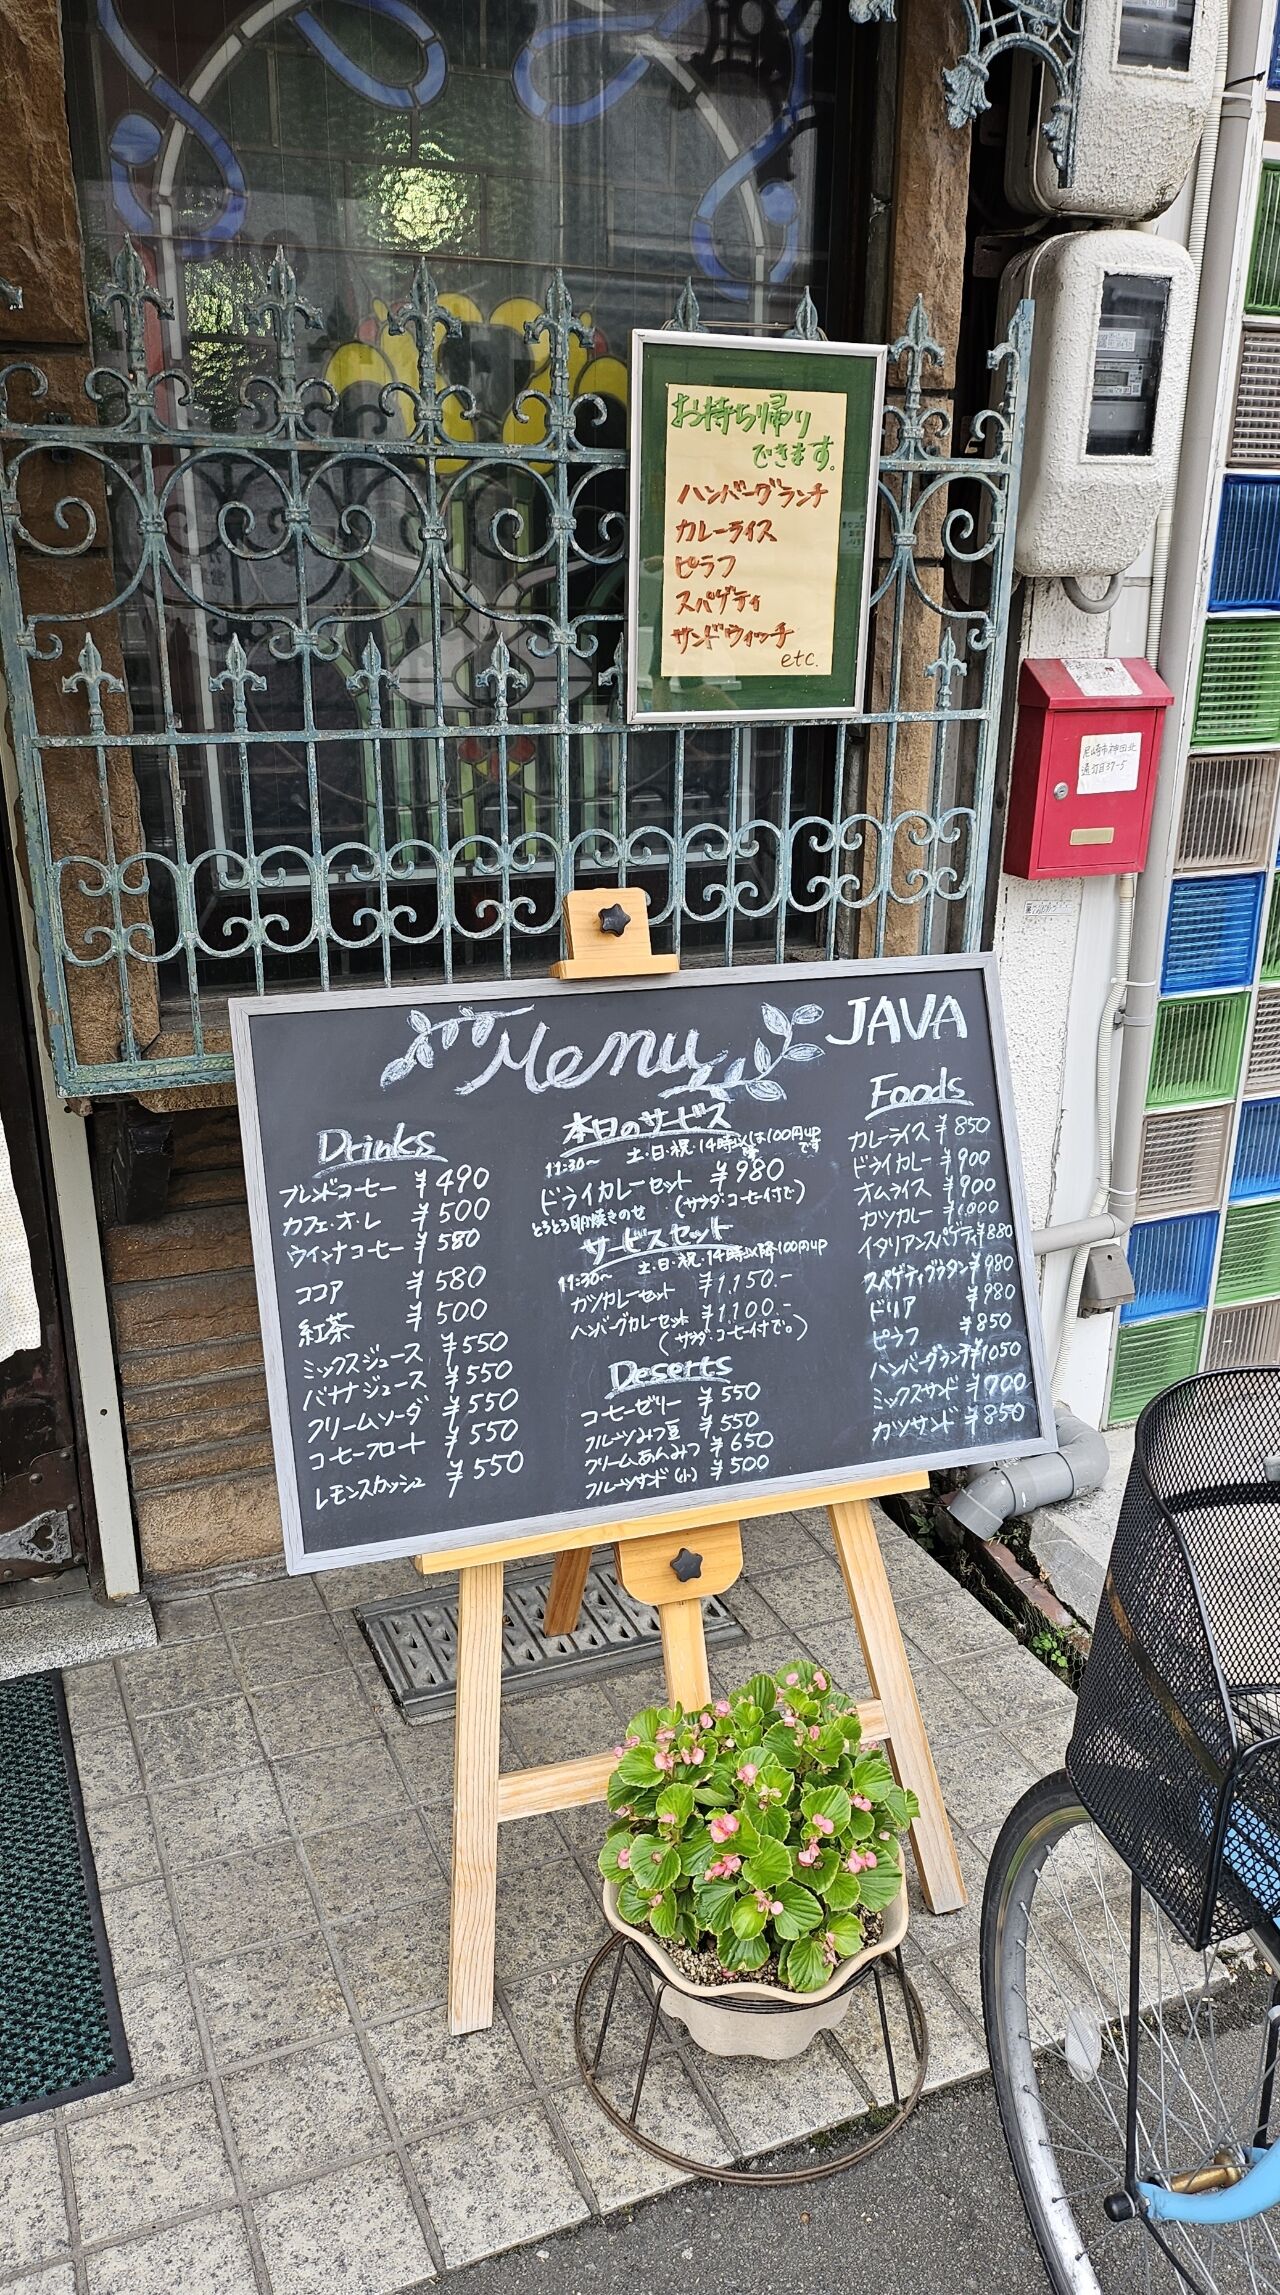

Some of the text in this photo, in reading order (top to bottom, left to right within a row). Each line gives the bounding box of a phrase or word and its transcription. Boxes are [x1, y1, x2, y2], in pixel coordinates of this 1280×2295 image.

[671, 393, 811, 438] お持ち帰り
[752, 435, 836, 471] できます。
[677, 479, 828, 508] ハンバーグランチ
[676, 519, 778, 544] カレーライス
[675, 555, 736, 579] ピラフ
[675, 586, 761, 615] スパゲティ
[671, 622, 794, 654] サンドウィッチ
[781, 650, 819, 668] etc.
[454, 994, 968, 1096] Menu JAVA
[870, 1067, 965, 1109] Foods
[562, 1102, 732, 1144] 本日のサービス
[848, 1114, 990, 1152] カレーライス ¥850
[316, 1122, 436, 1164] Drinks
[415, 1164, 489, 1198] ¥490
[854, 1147, 990, 1178] ドライカレー ¥900
[541, 1158, 784, 1215] ドライカレーセット ¥980
[854, 1175, 996, 1206] オムライス ¥900
[411, 1198, 490, 1231] ¥500
[532, 1204, 646, 1238] とろとろ卵焼きのせ
[860, 1208, 933, 1231] カツカレー
[414, 1228, 480, 1264] ¥580
[580, 1216, 733, 1264] サービスセット
[977, 1222, 1013, 1248] ¥880
[296, 1266, 487, 1305] ココア ¥580
[861, 1252, 1013, 1293] スパゲティグラタン ¥980
[571, 1282, 676, 1314] カツカレーセット
[870, 1283, 1015, 1322] ドリア ¥980
[298, 1300, 487, 1347] 紅茶 ¥500
[570, 1308, 690, 1340] ハンバーグカレーセット
[873, 1312, 1011, 1350] ピラフ ¥850
[304, 1331, 508, 1380] ミックスジュース ¥550
[608, 1356, 733, 1392] Deserts
[870, 1343, 971, 1379] ハンバーグランチ
[303, 1360, 513, 1411] バナナジュース ¥550
[581, 1382, 761, 1427] コーヒーゼリー ¥550
[874, 1373, 1026, 1409] ミックスサンド ¥700
[308, 1388, 518, 1443] クリームソーダ ¥550
[585, 1411, 759, 1454] フルーツみつ豆 ¥550
[872, 1402, 1025, 1441] カツサンド ¥850
[309, 1419, 518, 1470] コーヒーフロート ¥550
[585, 1431, 773, 1475] クリームあんみつ ¥650
[315, 1451, 524, 1511] レモンスカッシュ ¥550
[710, 1455, 769, 1481] ¥500
